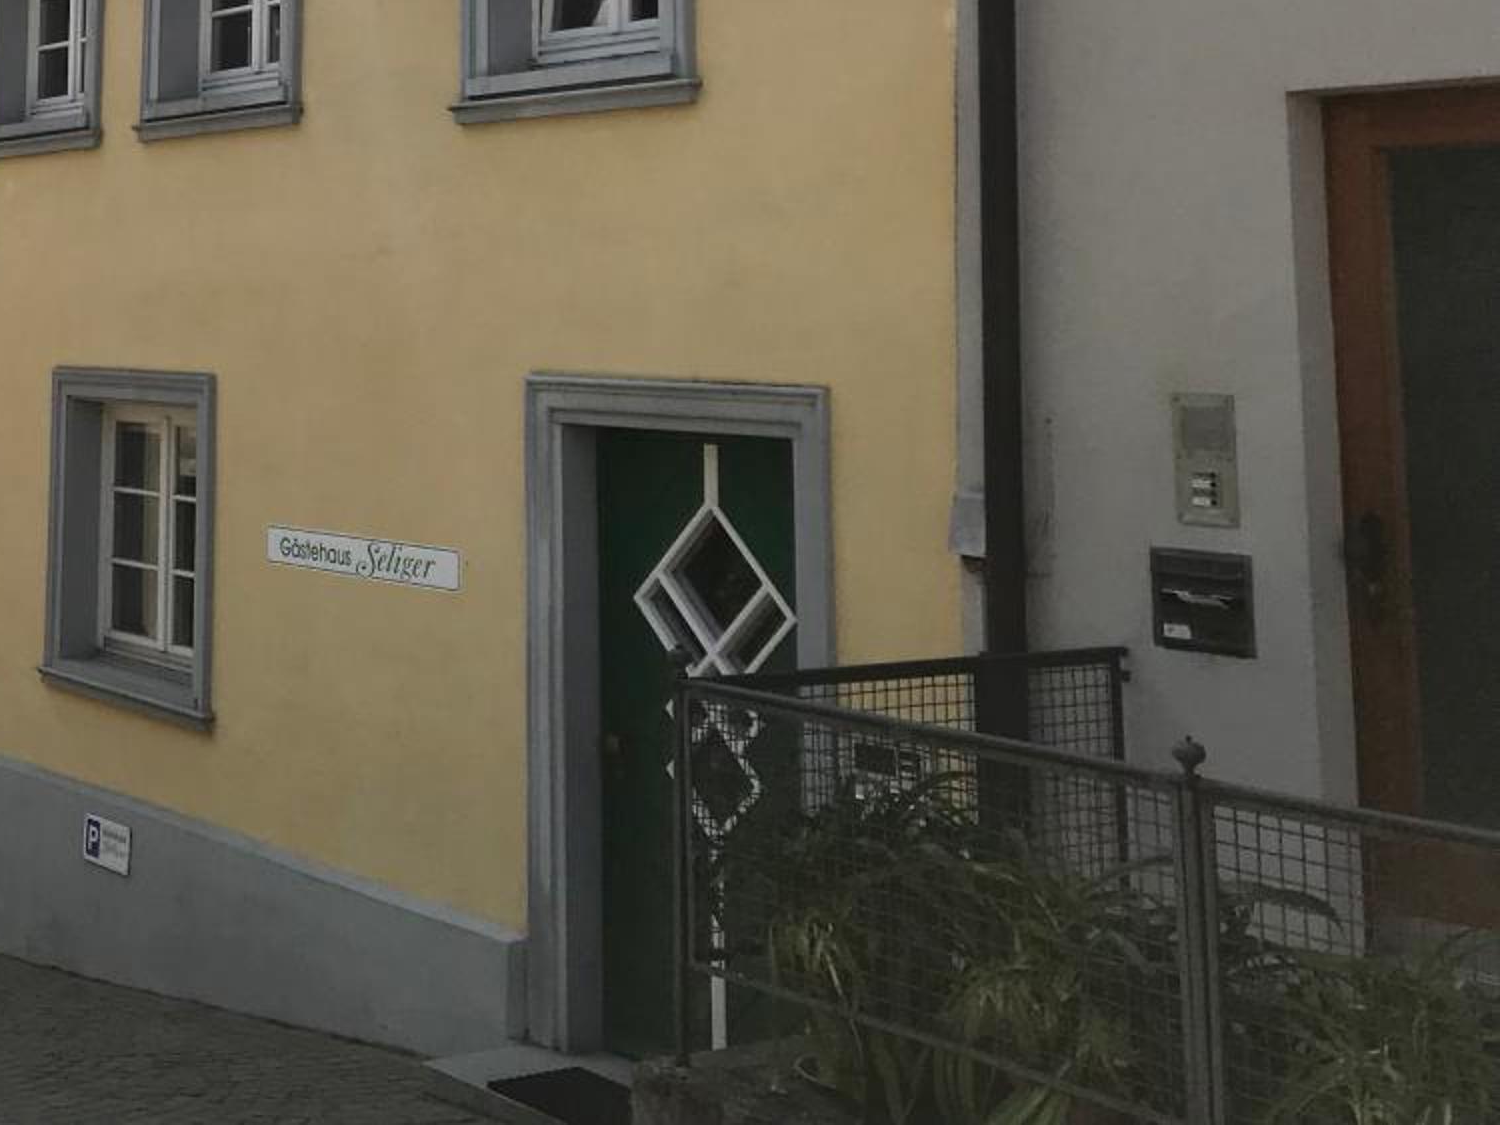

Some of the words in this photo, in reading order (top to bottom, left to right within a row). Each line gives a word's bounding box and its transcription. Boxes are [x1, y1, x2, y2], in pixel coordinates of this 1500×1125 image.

[280, 536, 352, 567] Gästehaus
[356, 541, 436, 579] Seliger
[88, 824, 99, 851] P
